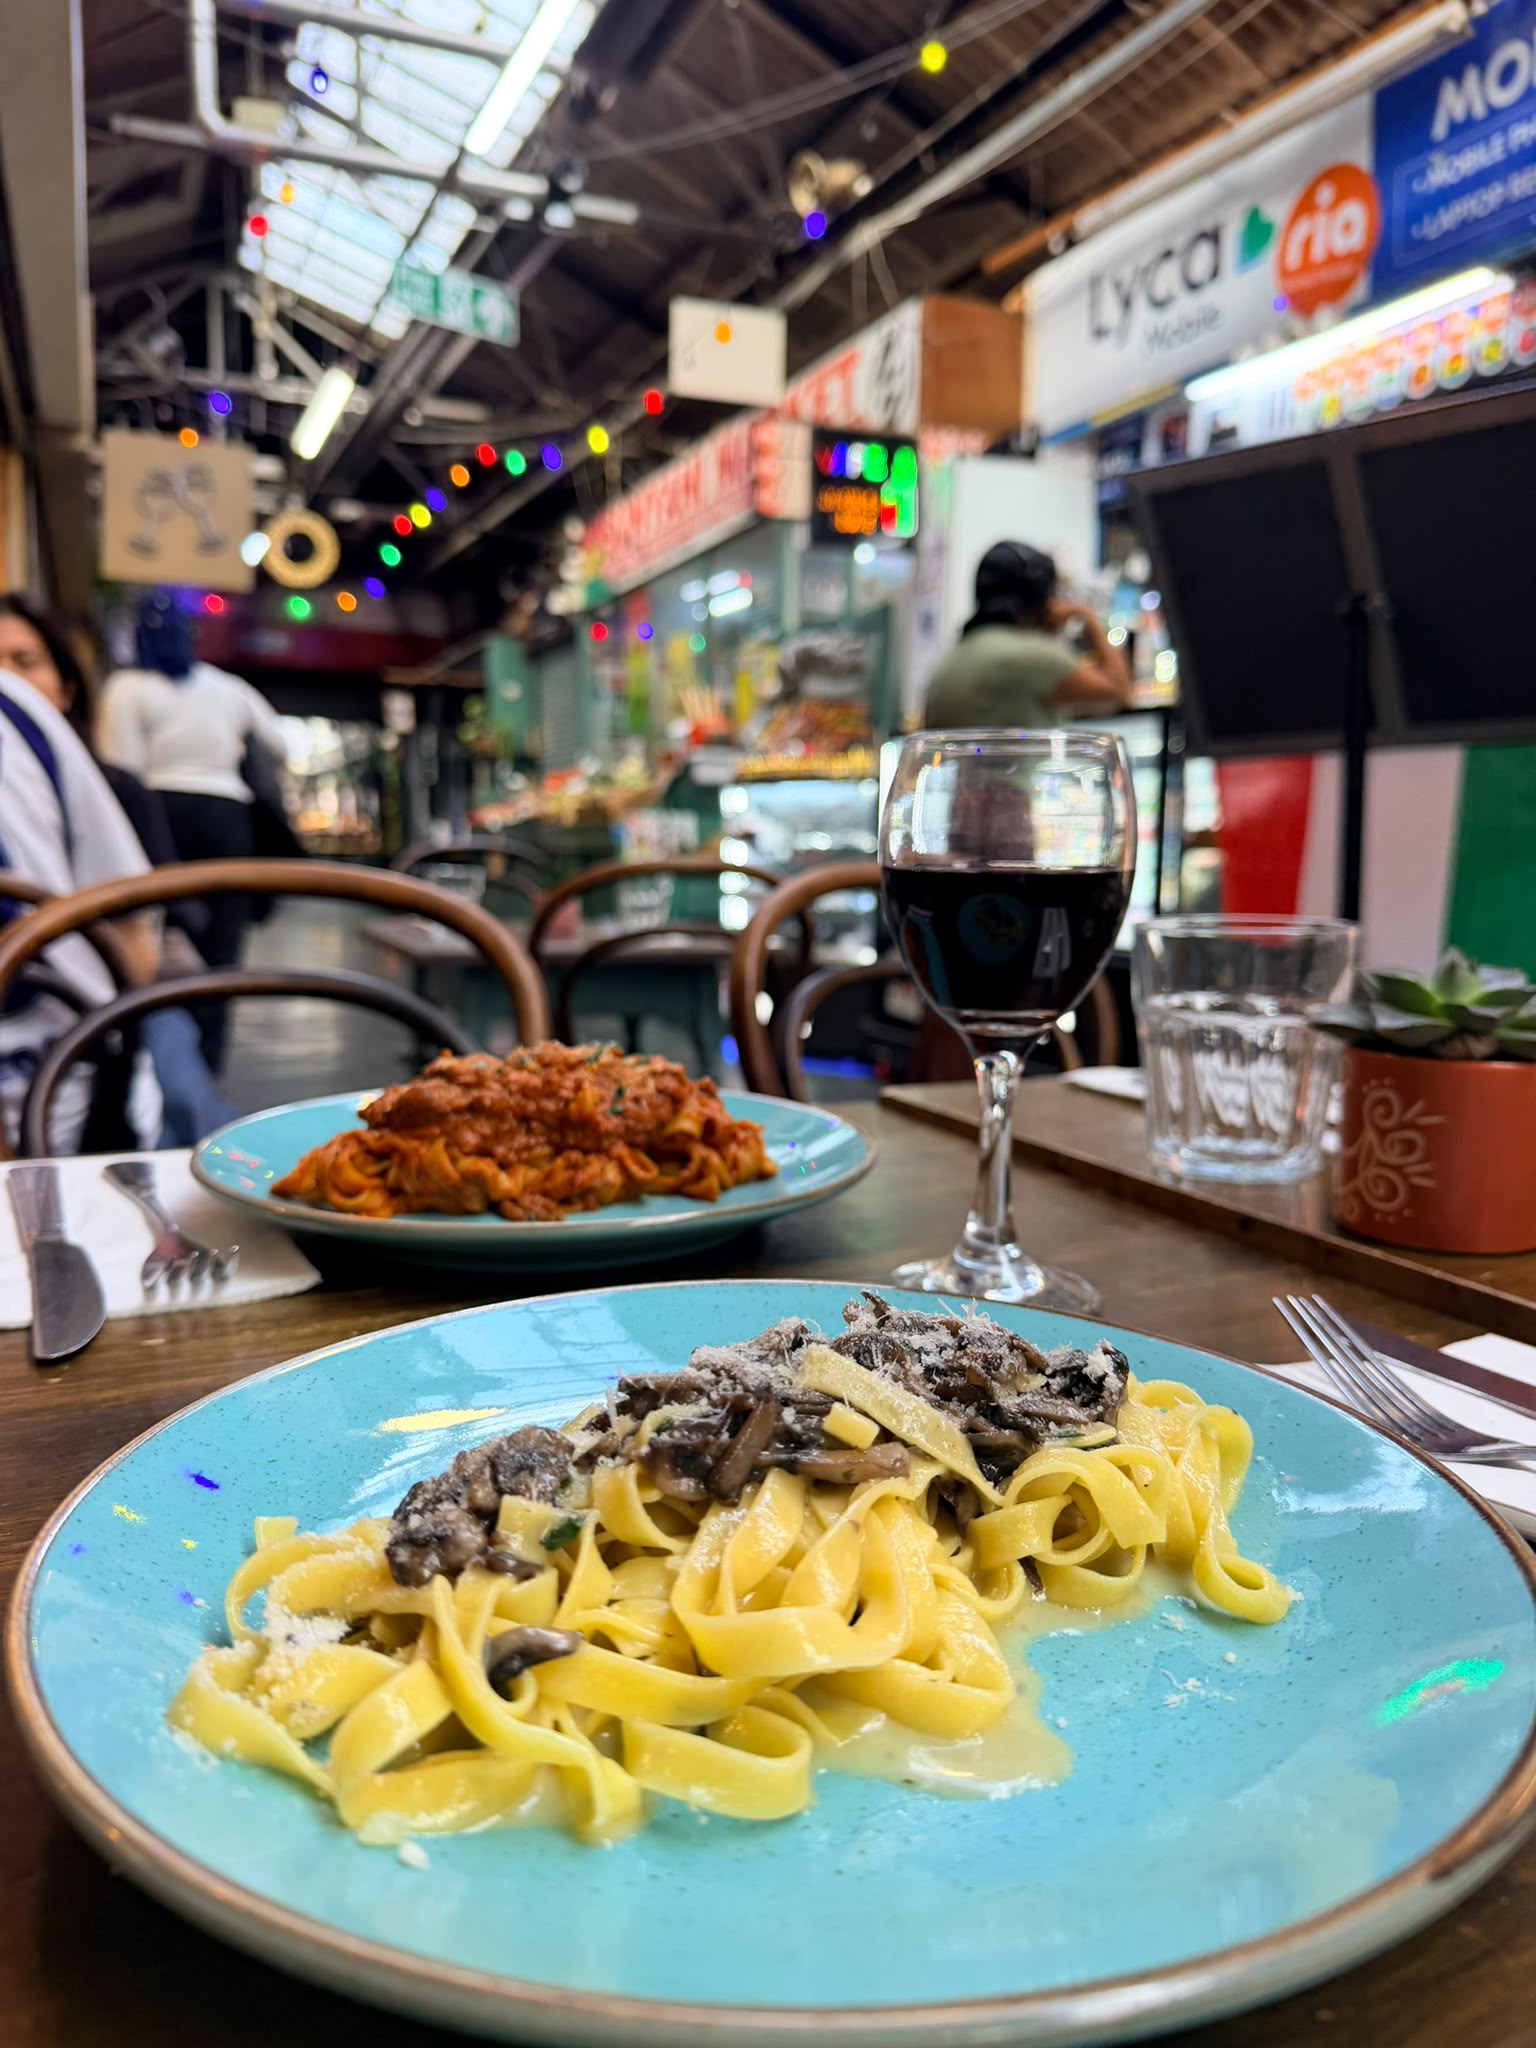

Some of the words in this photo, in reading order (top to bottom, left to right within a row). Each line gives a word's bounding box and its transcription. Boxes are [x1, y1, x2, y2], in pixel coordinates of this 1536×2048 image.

[1430, 28, 1536, 142] MO
[1284, 180, 1368, 272] ria
[1089, 222, 1220, 350] Lyca
